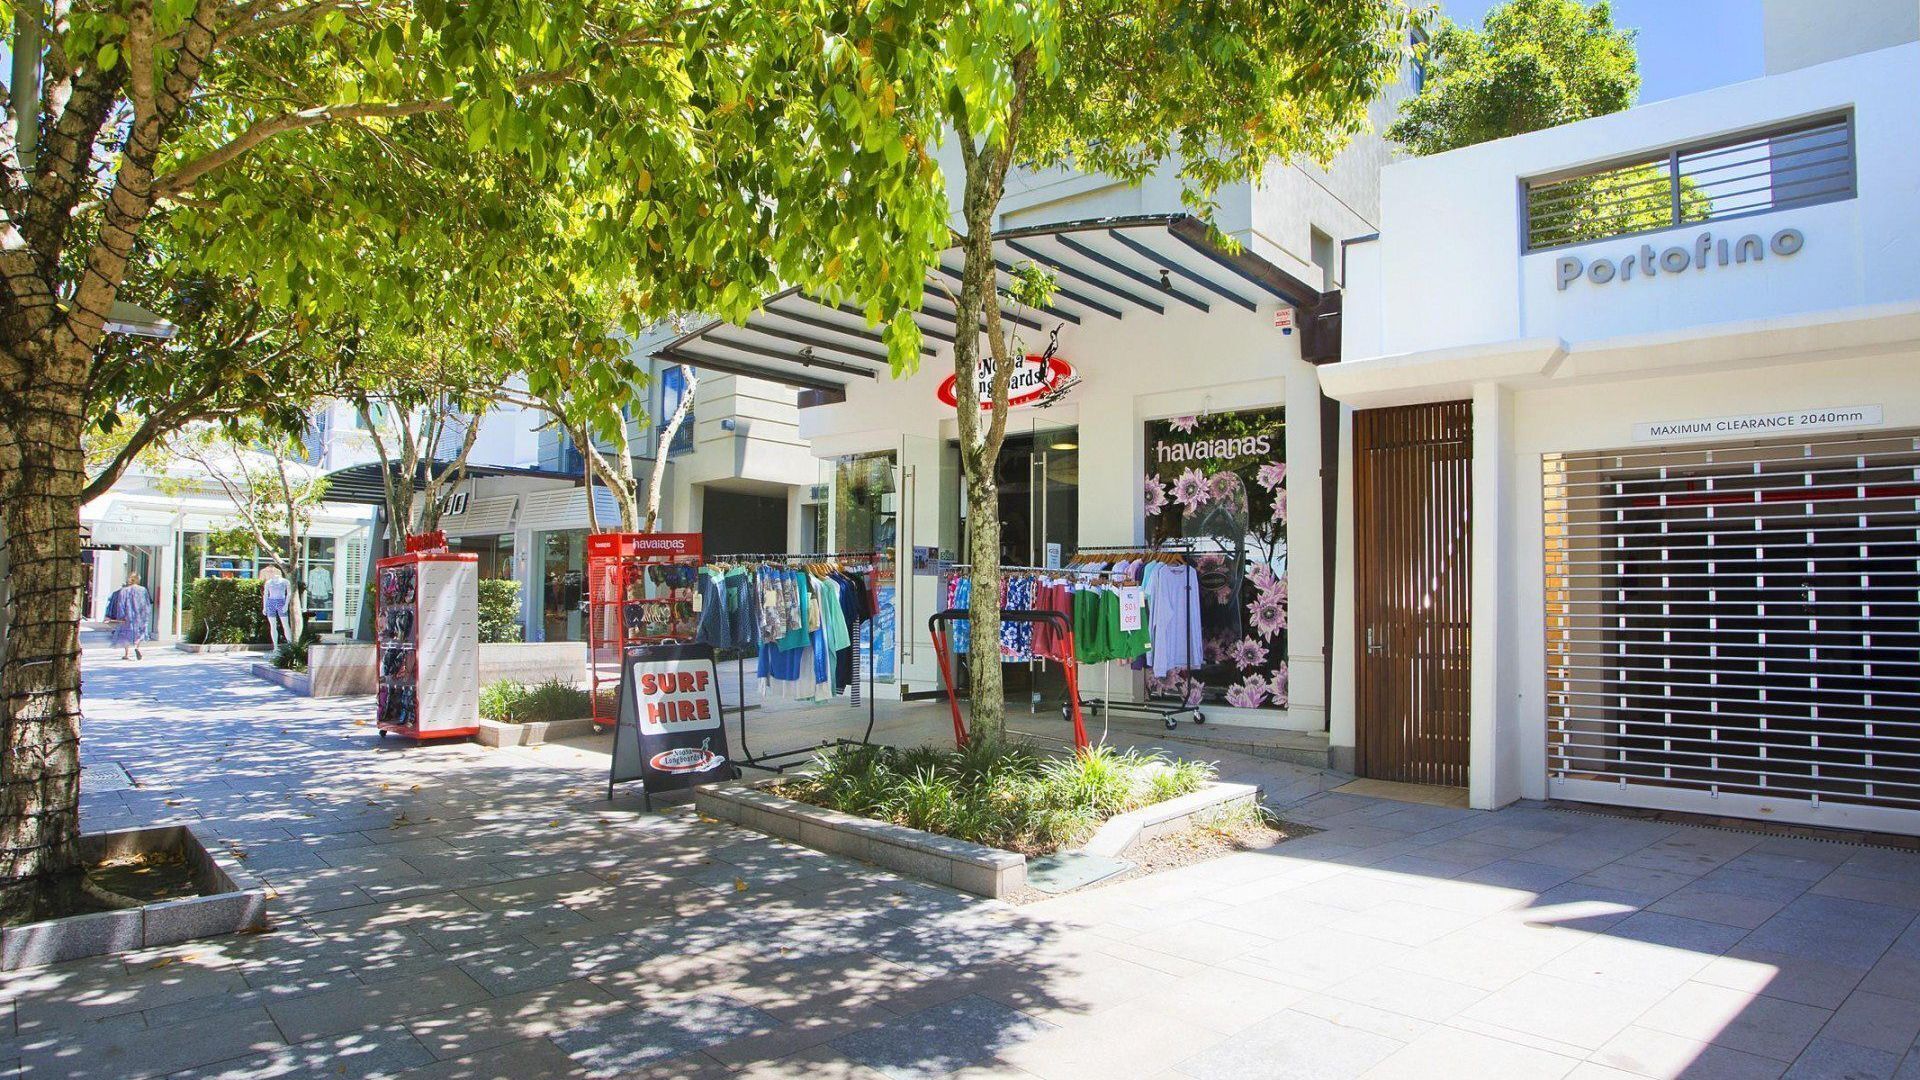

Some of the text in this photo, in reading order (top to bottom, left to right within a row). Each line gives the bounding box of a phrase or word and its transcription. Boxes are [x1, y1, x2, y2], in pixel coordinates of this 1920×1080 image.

[1556, 229, 1804, 291] Portofino
[1651, 411, 1863, 436] MAXIMUM CLEARANCE 2040mm
[1156, 435, 1271, 462] havaianas
[632, 538, 685, 550] havaianas
[641, 670, 709, 695] SURF
[647, 698, 711, 724] HIRE
